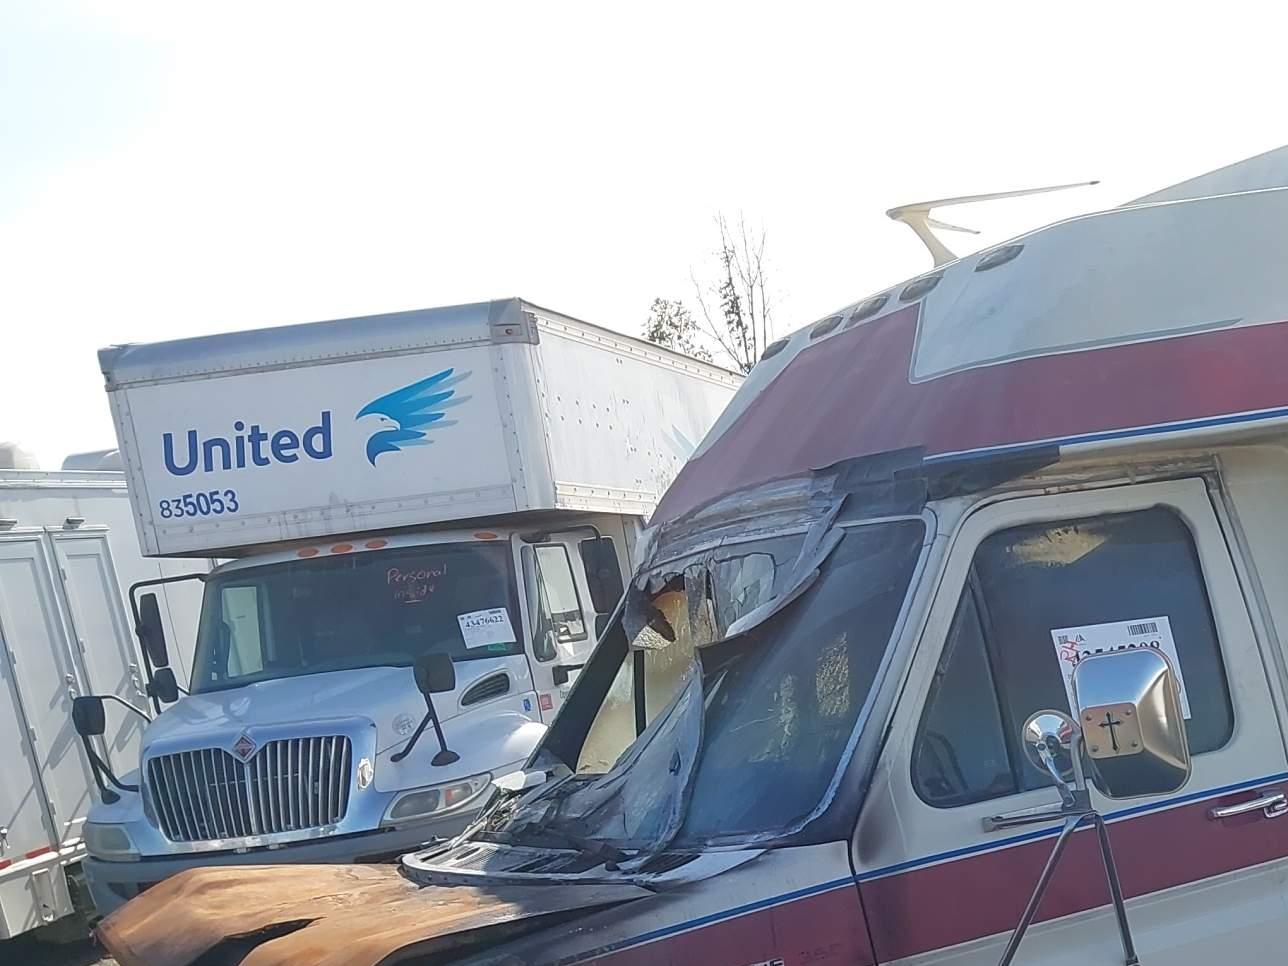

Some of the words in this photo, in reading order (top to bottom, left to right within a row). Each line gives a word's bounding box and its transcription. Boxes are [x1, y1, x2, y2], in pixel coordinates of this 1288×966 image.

[163, 410, 332, 477] United
[159, 489, 239, 519] 835053
[387, 563, 447, 584] Personal
